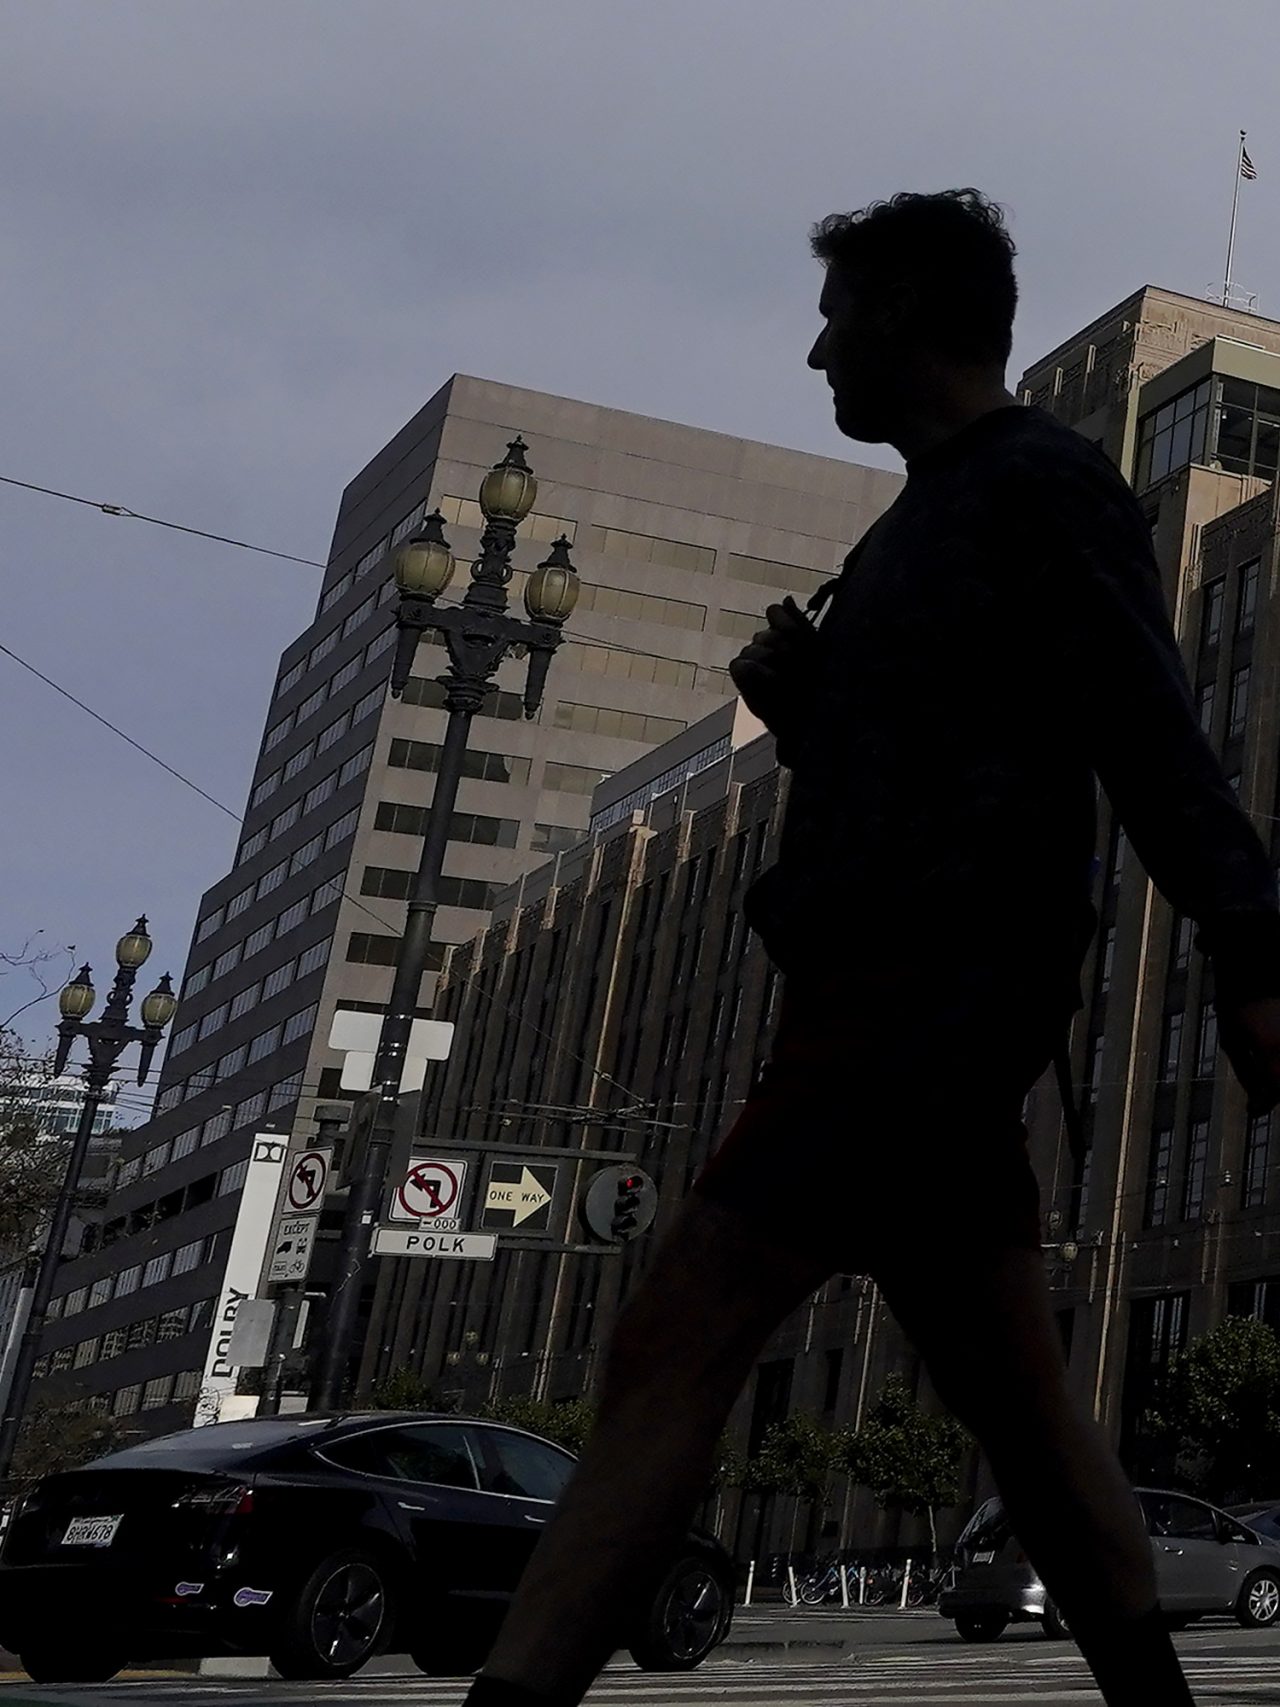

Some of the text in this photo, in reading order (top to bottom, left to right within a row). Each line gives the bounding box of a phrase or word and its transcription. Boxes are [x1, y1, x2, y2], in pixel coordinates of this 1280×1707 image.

[489, 1190, 545, 1204] ONE WAY
[406, 1235, 466, 1253] POLK
